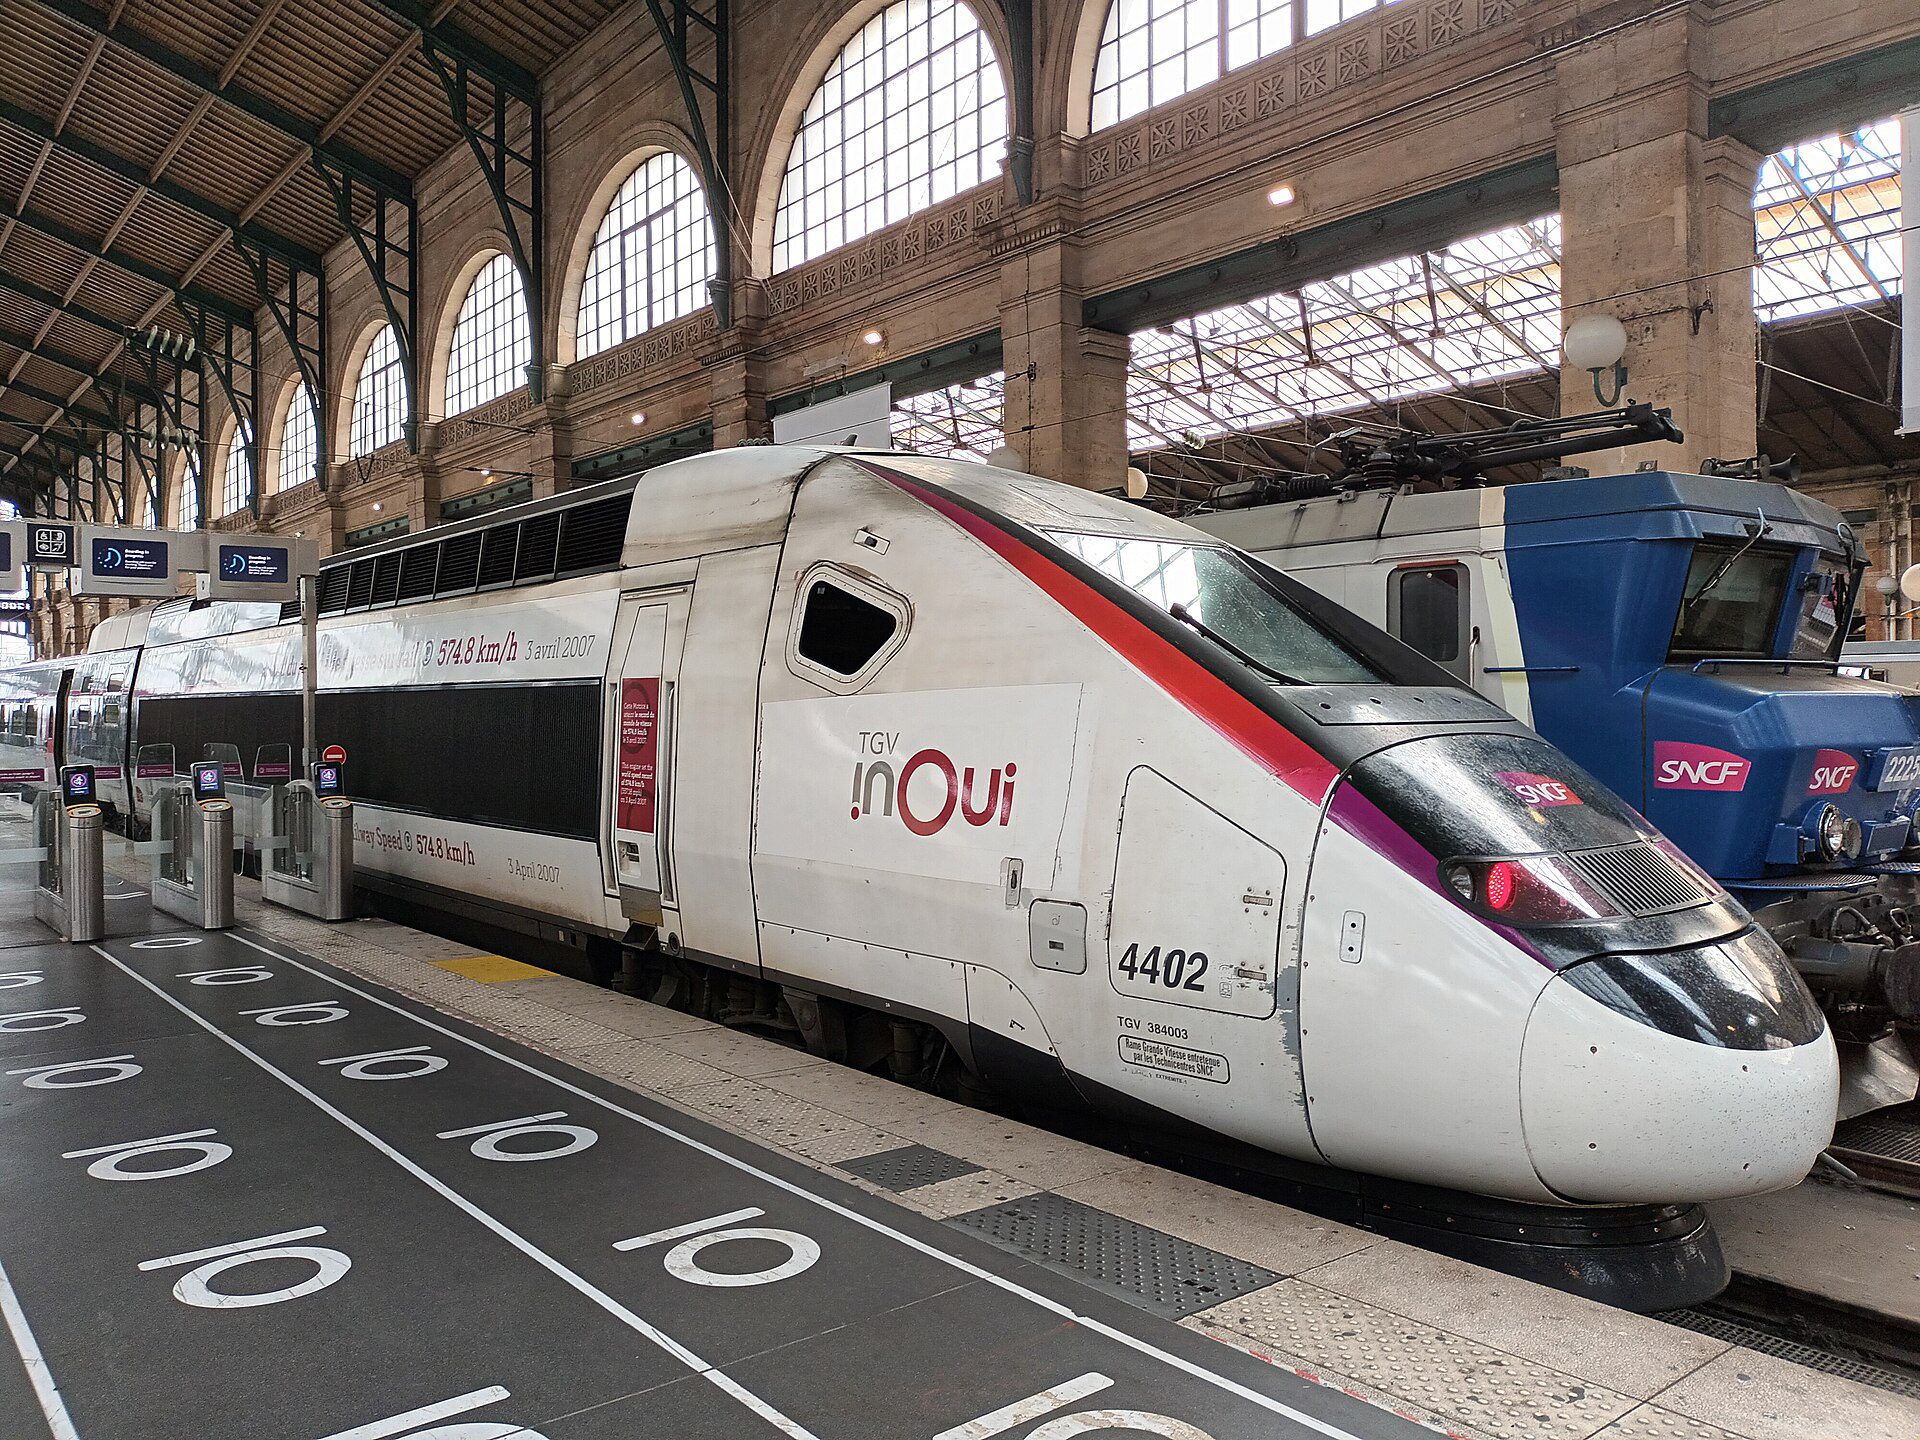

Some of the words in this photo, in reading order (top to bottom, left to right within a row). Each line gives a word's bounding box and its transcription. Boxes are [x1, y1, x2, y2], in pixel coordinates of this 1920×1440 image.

[437, 636, 476, 667] 574.8
[476, 630, 519, 665] km/h
[524, 640, 534, 661] 3
[535, 637, 560, 660] avril
[561, 634, 596, 659] 2007
[859, 731, 900, 755] TGV
[1657, 760, 1743, 785] SNCF
[1809, 765, 1855, 790] SNCF
[1884, 755, 1920, 783] 2225
[1515, 782, 1567, 804] SNCF
[353, 822, 375, 849] ilway
[375, 826, 403, 852] Speed
[416, 834, 444, 859] 574.8
[445, 838, 476, 866] km/h
[508, 858, 514, 874] 3
[515, 860, 536, 881] April
[537, 863, 560, 883] 2007
[1118, 942, 1209, 993] 4402
[1117, 1016, 1141, 1030] TGV
[1147, 1022, 1189, 1040] 384003
[1125, 1038, 1142, 1051] Rame
[1142, 1041, 1164, 1056] Grande
[1164, 1045, 1187, 1060] Vitesse
[1187, 1052, 1221, 1068] entretenue
[1133, 1052, 1143, 1063] par
[1144, 1053, 1153, 1064] les
[1154, 1054, 1196, 1073] Technicentres
[1196, 1063, 1214, 1077] SNCF
